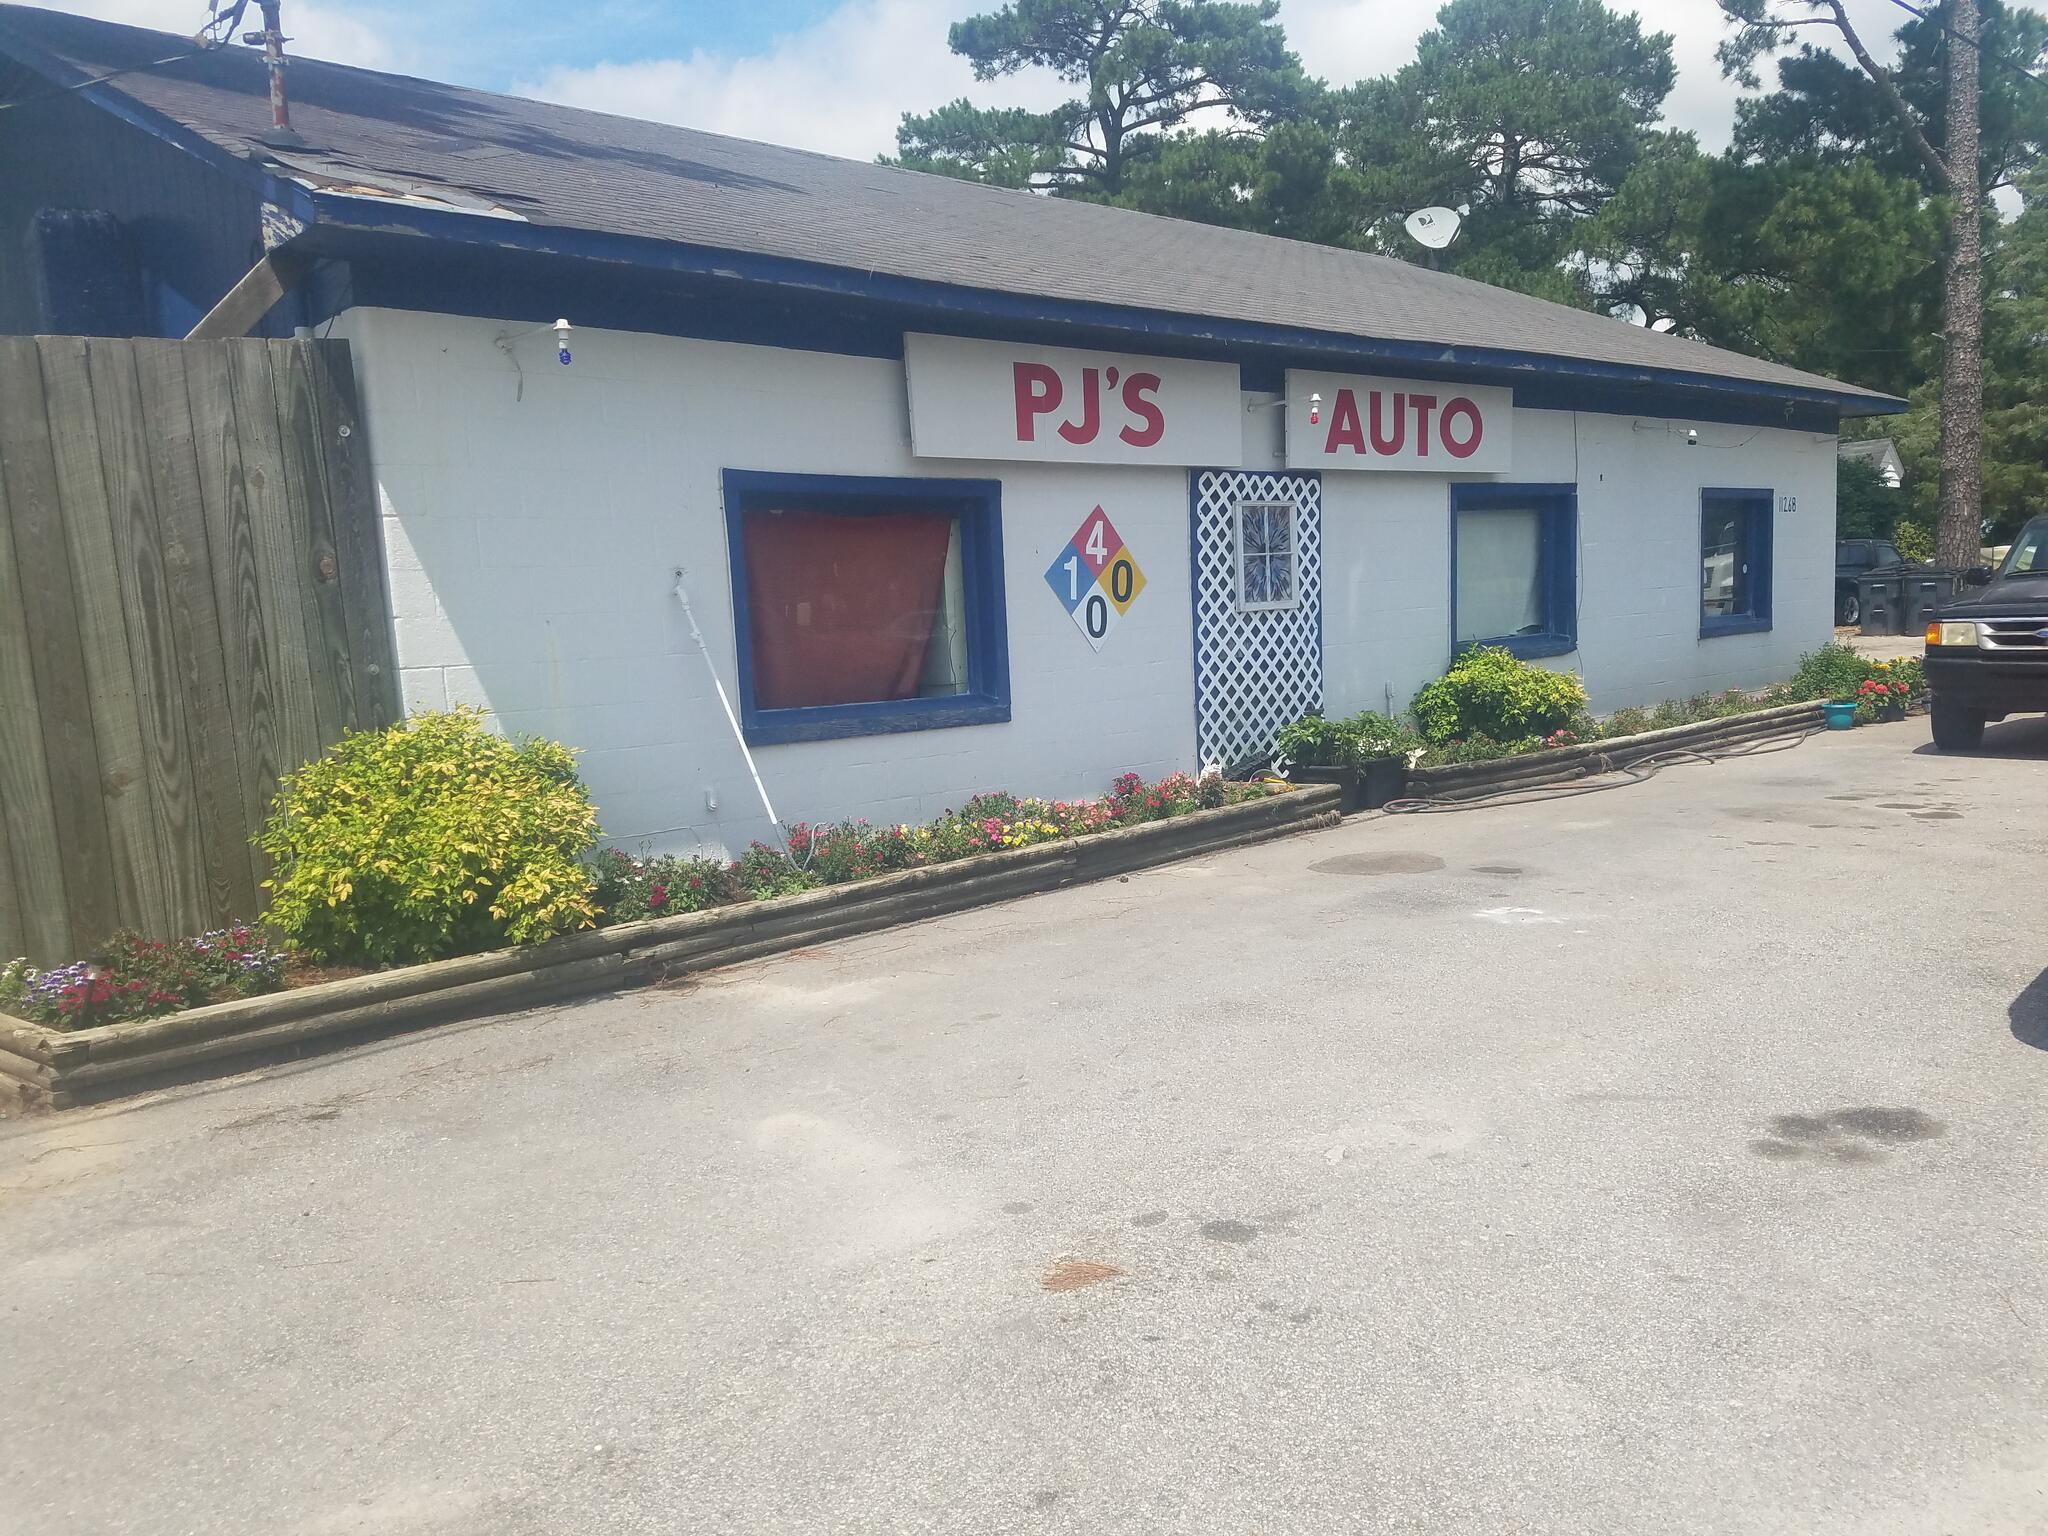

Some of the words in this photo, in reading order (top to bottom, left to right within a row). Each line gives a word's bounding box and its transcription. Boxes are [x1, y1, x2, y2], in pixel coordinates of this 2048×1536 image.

[1012, 361, 1166, 448] PJ'S
[1324, 388, 1484, 459] AUTO
[1084, 519, 1109, 567] 4
[1063, 556, 1078, 600] 1
[1111, 559, 1134, 603] 0
[1085, 595, 1108, 639] 0
